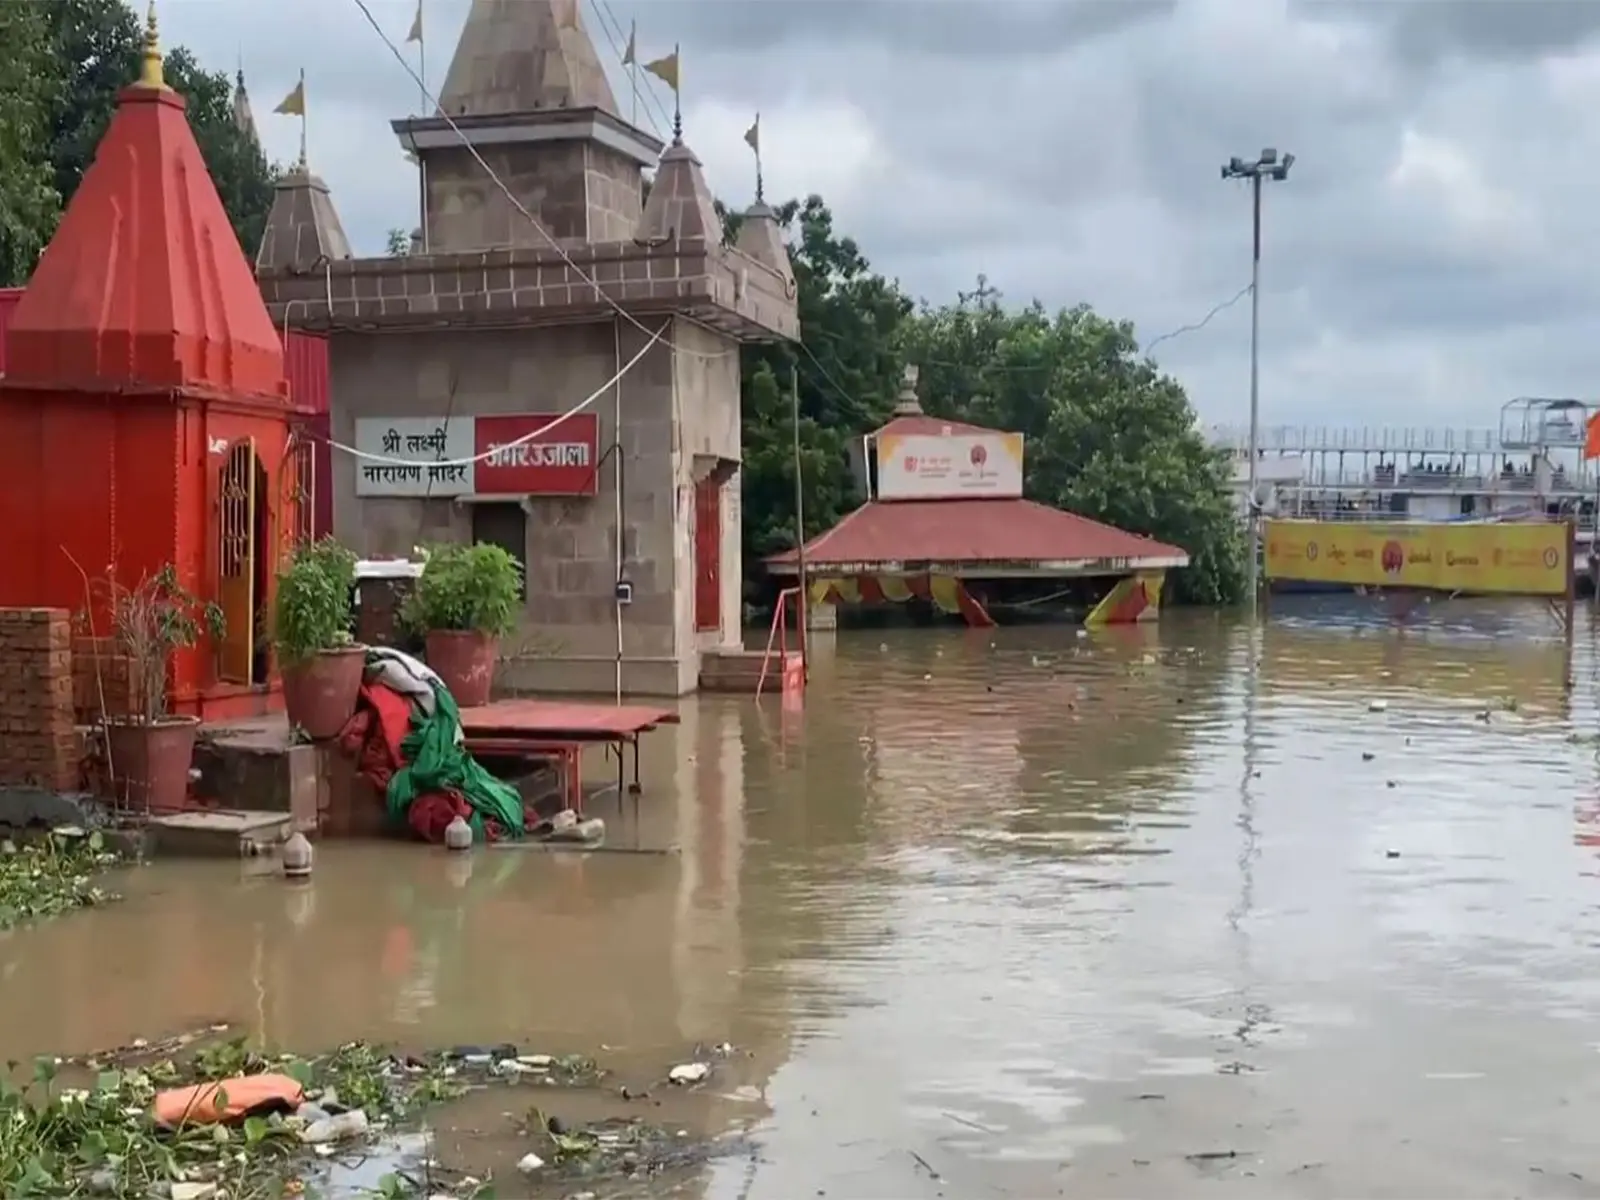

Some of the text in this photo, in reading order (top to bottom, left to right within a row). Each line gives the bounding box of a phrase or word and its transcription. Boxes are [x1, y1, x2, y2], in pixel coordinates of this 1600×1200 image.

[382, 427, 447, 453] श्री लक्ष्मी
[363, 464, 422, 484] नारायण
